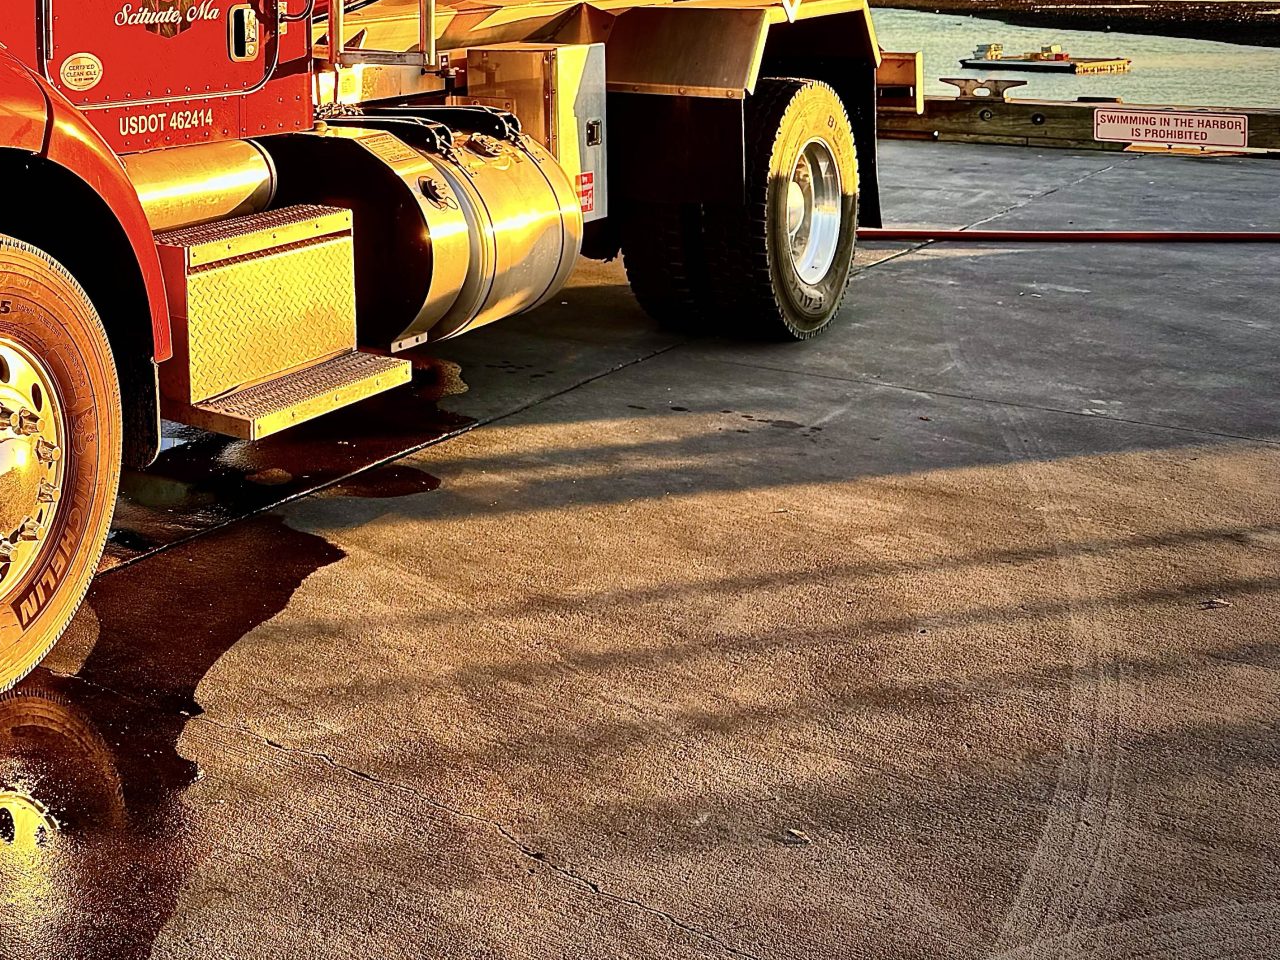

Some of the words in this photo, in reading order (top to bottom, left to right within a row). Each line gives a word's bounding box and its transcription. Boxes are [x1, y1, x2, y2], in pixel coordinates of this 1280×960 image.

[114, 3, 183, 26] Scituate,
[186, 0, 221, 22] Ma
[119, 112, 167, 136] USDOT
[169, 108, 214, 130] 462414
[1100, 114, 1157, 126] SWIMMING
[1160, 117, 1170, 127] IN
[1174, 118, 1194, 129] THE
[1197, 120, 1242, 131] HARBOR
[1131, 128, 1141, 138] IS
[1144, 128, 1208, 141] PROHIBITED
[20, 462, 93, 626] MICHELIN
